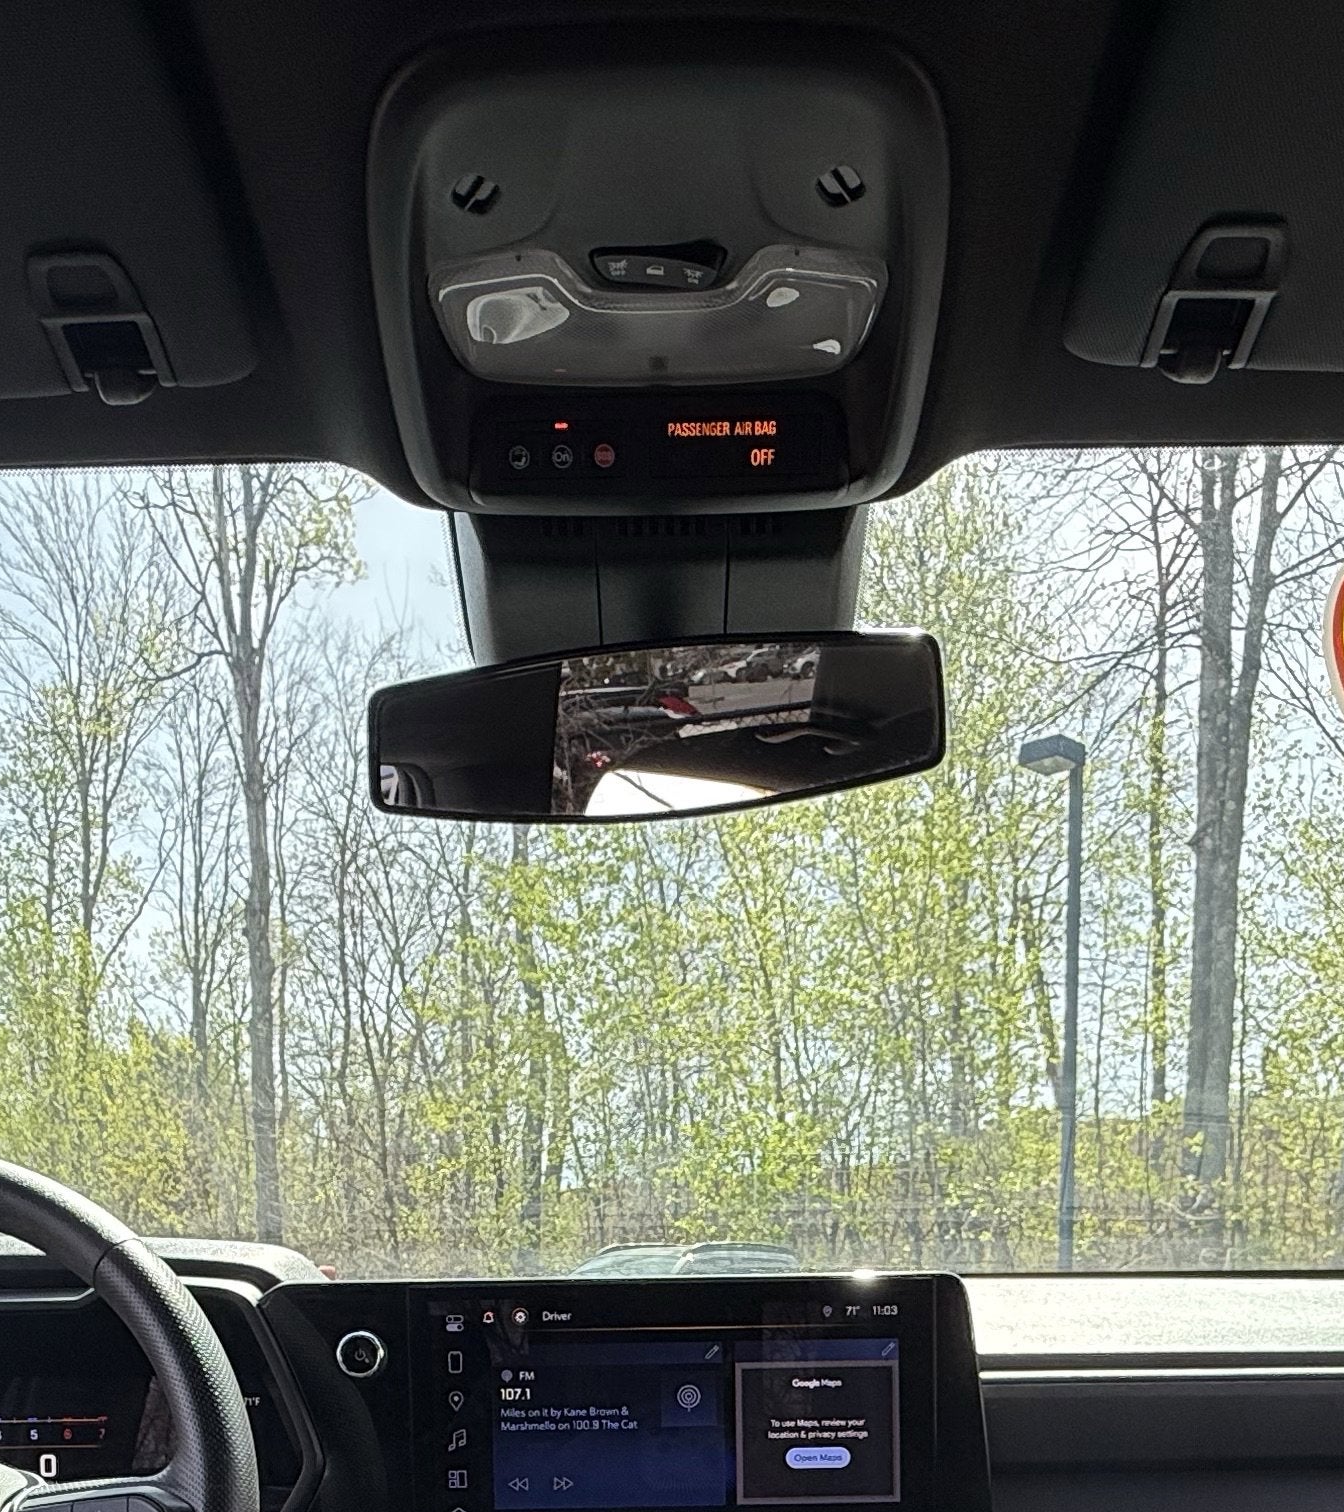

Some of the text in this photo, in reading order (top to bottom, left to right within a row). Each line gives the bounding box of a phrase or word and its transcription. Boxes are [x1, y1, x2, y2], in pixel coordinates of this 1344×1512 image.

[668, 420, 777, 437] PASSENGER AIR BAG
[554, 450, 570, 462] On
[750, 449, 776, 467] OFF
[872, 1305, 899, 1316] 11:03
[542, 1311, 573, 1322] Driver
[519, 1371, 535, 1381] FM
[792, 1378, 842, 1389] Google Maps
[500, 1388, 531, 1400] 107.1
[500, 1408, 526, 1418] Miles
[528, 1410, 540, 1418] on
[550, 1408, 561, 1420] by
[563, 1407, 587, 1417] Kane
[589, 1406, 619, 1416] Brown
[620, 1406, 629, 1416] &
[500, 1421, 556, 1431] Marshmello
[601, 1420, 619, 1429] The
[621, 1420, 638, 1429] Cat
[770, 1419, 780, 1427] To
[821, 1419, 846, 1427] review
[847, 1420, 865, 1428] your
[30, 1430, 39, 1440] 5
[63, 1429, 73, 1440] 6
[768, 1430, 798, 1439] location
[808, 1431, 836, 1439] privacy
[837, 1430, 868, 1440] settings
[794, 1454, 843, 1463] Open Maps
[40, 1453, 57, 1477] 0
